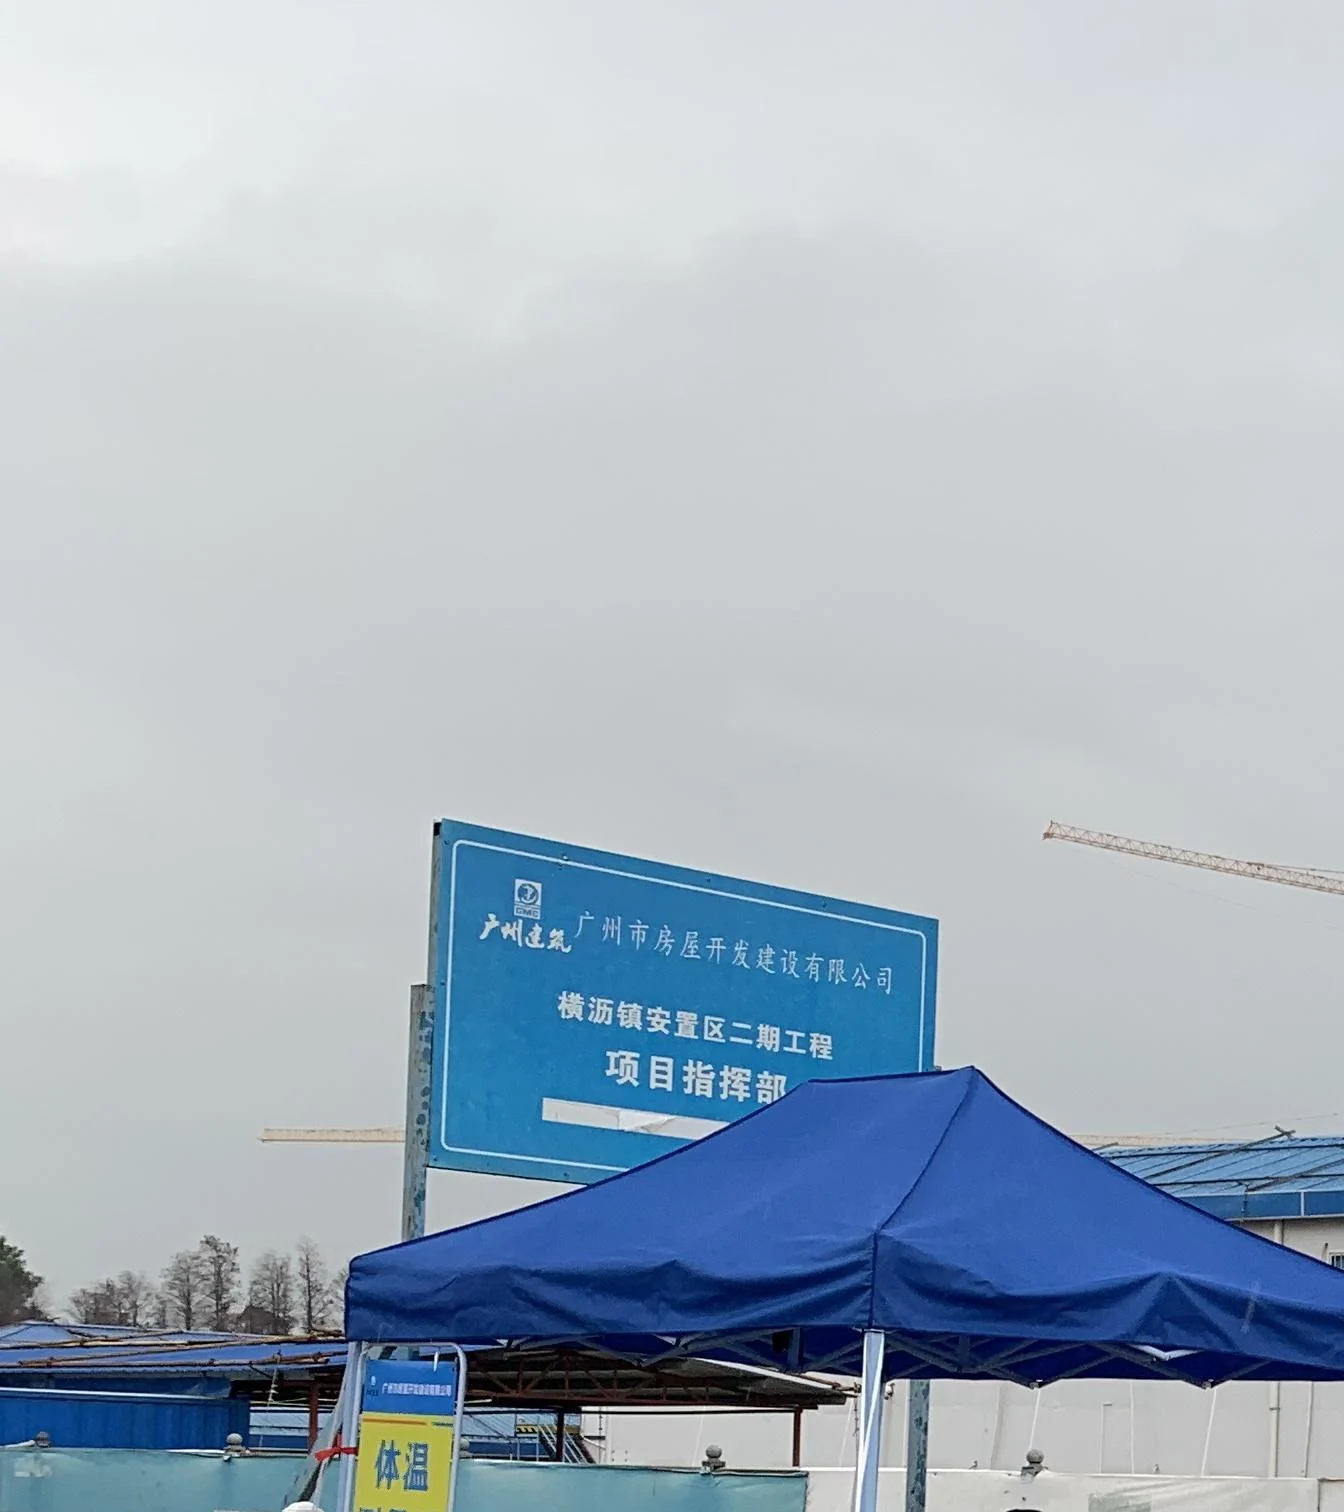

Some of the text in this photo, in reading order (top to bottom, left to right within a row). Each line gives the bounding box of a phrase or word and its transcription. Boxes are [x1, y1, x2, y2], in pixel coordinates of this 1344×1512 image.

[480, 913, 572, 953] 广州建筑
[574, 910, 893, 995] 广州市房屋开发建设有限公司
[557, 990, 833, 1061] 横沥镇安置区二期工程
[605, 1049, 787, 1105] 项目指挥部
[374, 1439, 429, 1491] 体温
